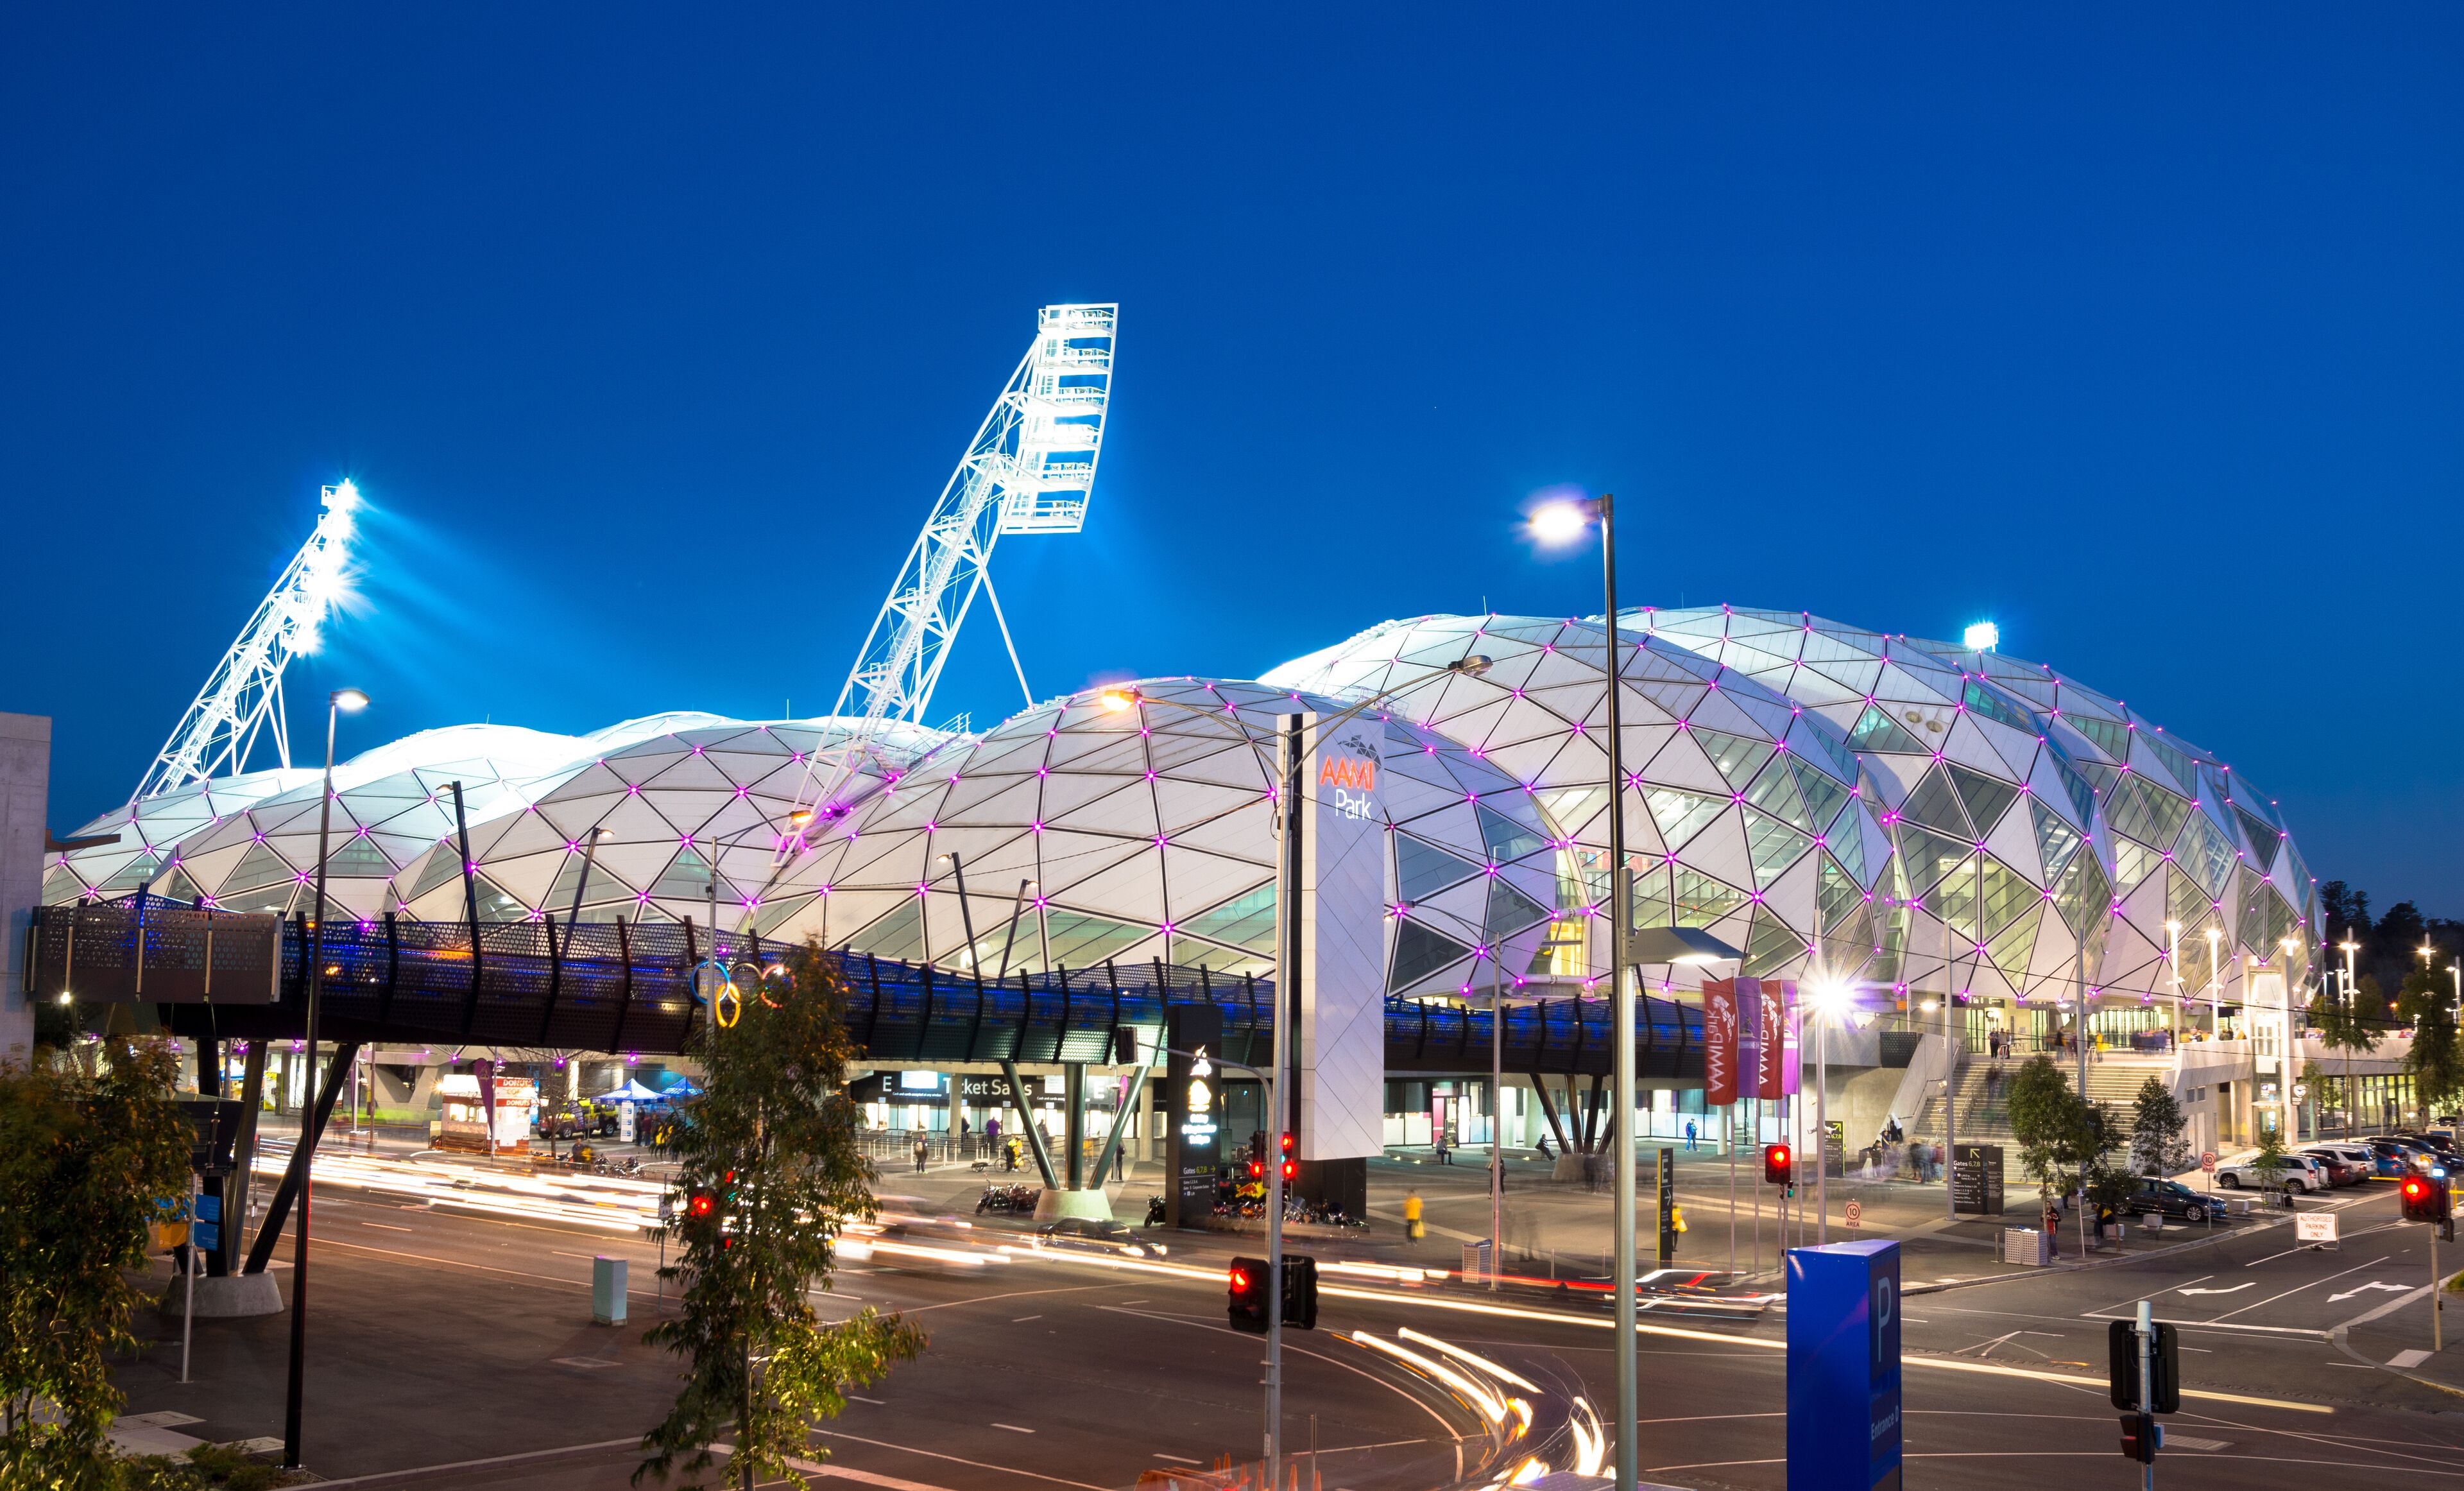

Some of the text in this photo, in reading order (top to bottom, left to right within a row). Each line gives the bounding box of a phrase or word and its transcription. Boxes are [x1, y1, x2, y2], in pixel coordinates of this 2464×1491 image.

[1320, 755, 1373, 791] AAMI
[1335, 788, 1372, 820] Park
[503, 1078, 532, 1087] DONUTS
[883, 1076, 892, 1092] E
[943, 1077, 988, 1095] Tket
[991, 1079, 1032, 1096] Sas
[1093, 1082, 1105, 1099] E
[1196, 1166, 1208, 1174] 6,7,8
[1661, 1158, 1668, 1184] E
[1849, 1208, 1857, 1216] 10
[1878, 1277, 1892, 1363] P
[1871, 1412, 1894, 1442] Entrance
